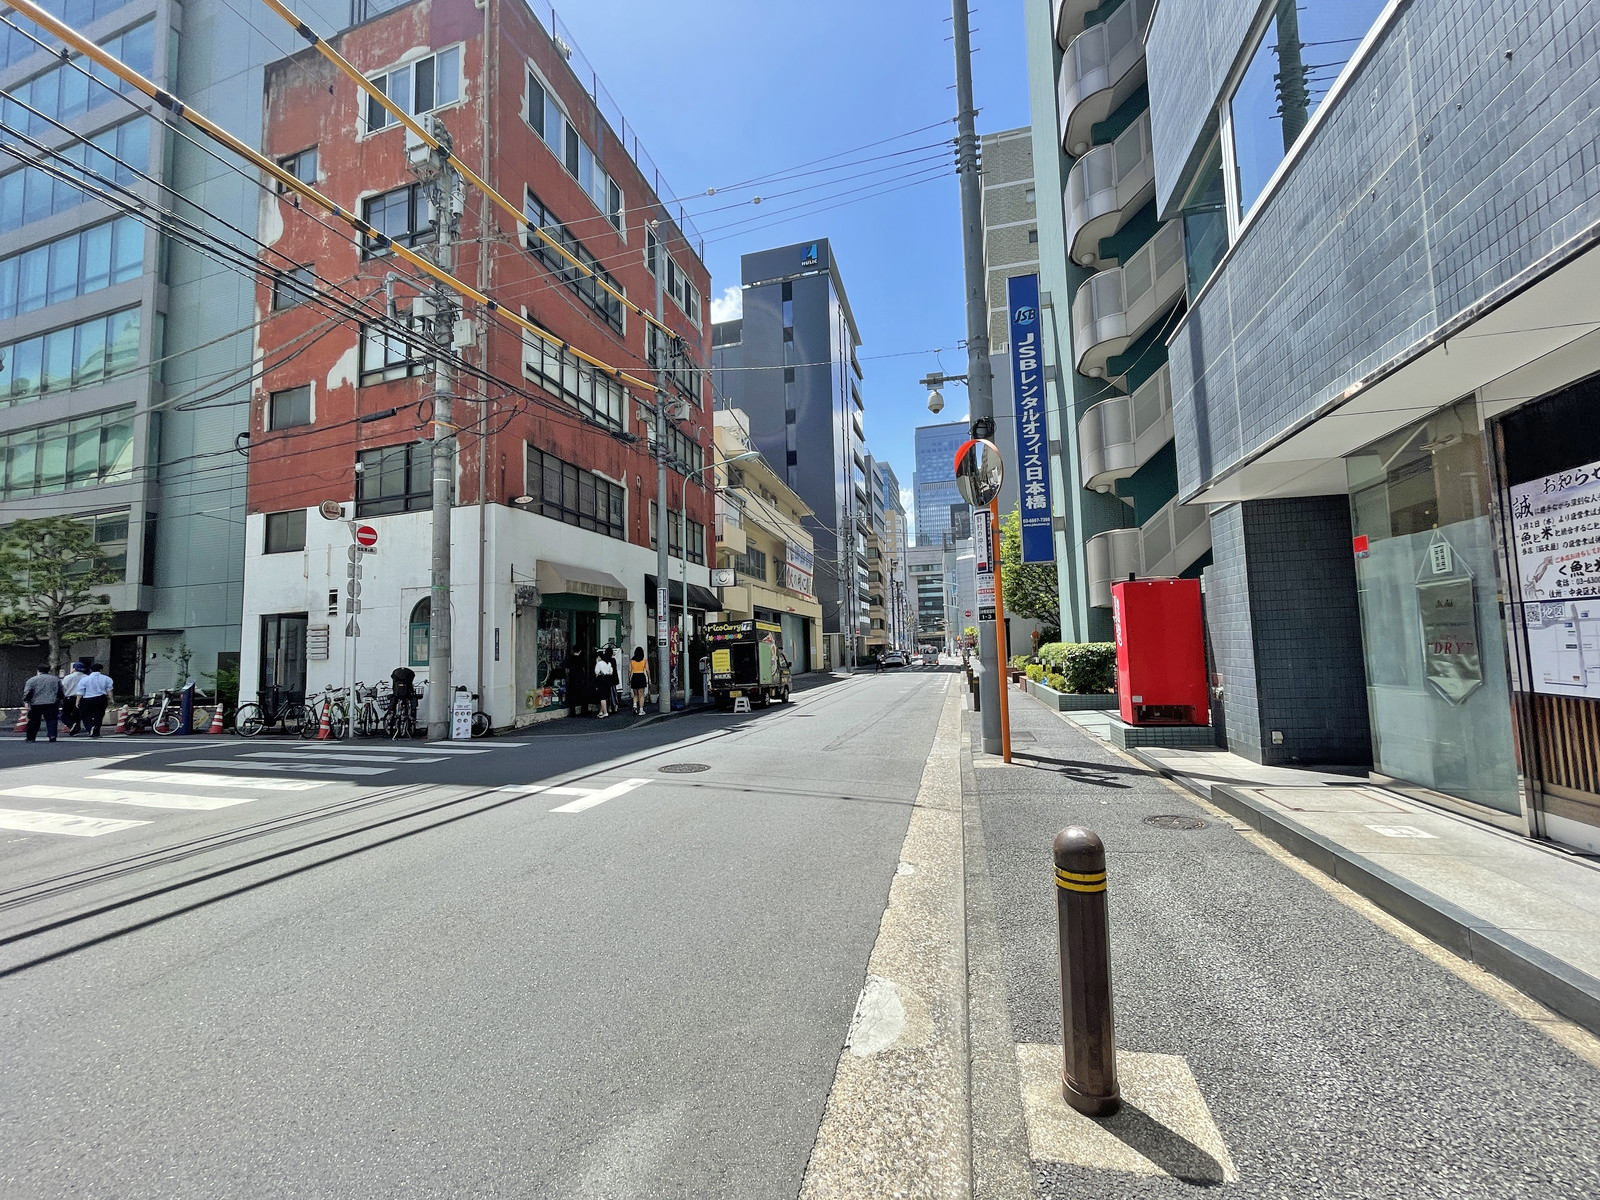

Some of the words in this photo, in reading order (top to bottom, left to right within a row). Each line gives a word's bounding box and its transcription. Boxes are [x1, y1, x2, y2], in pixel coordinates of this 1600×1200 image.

[1014, 308, 1036, 324] JSB
[1018, 333, 1047, 510] JSBレンタルオフィス日本橋
